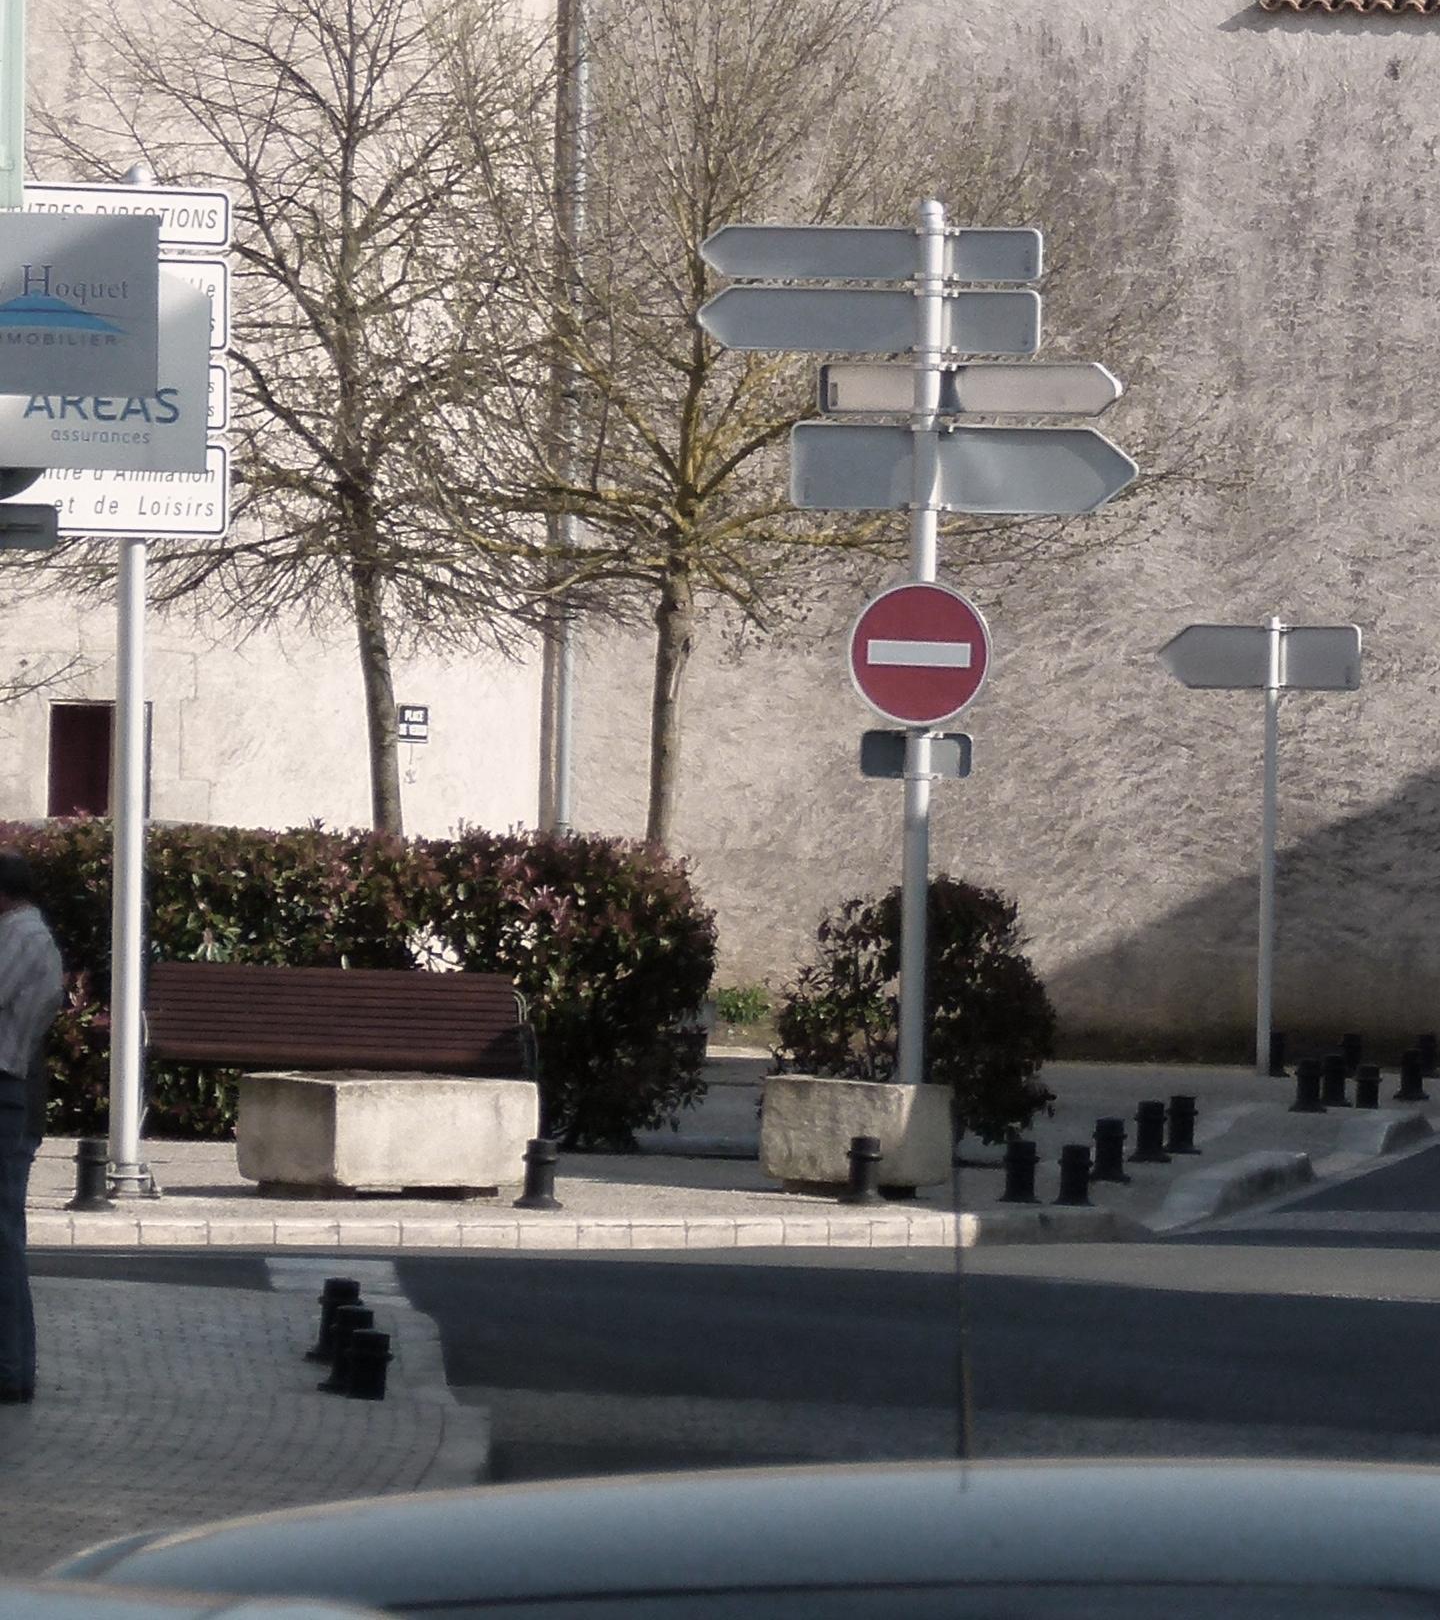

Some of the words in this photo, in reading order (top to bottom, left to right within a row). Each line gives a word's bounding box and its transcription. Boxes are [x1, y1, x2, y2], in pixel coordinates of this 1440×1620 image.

[21, 264, 129, 306] Hoquet
[0, 332, 118, 347] MOBILIER
[23, 387, 180, 424] AREAS
[51, 429, 151, 444] assurances
[54, 496, 75, 514] et
[94, 495, 119, 514] de
[139, 496, 215, 517] Loisirs
